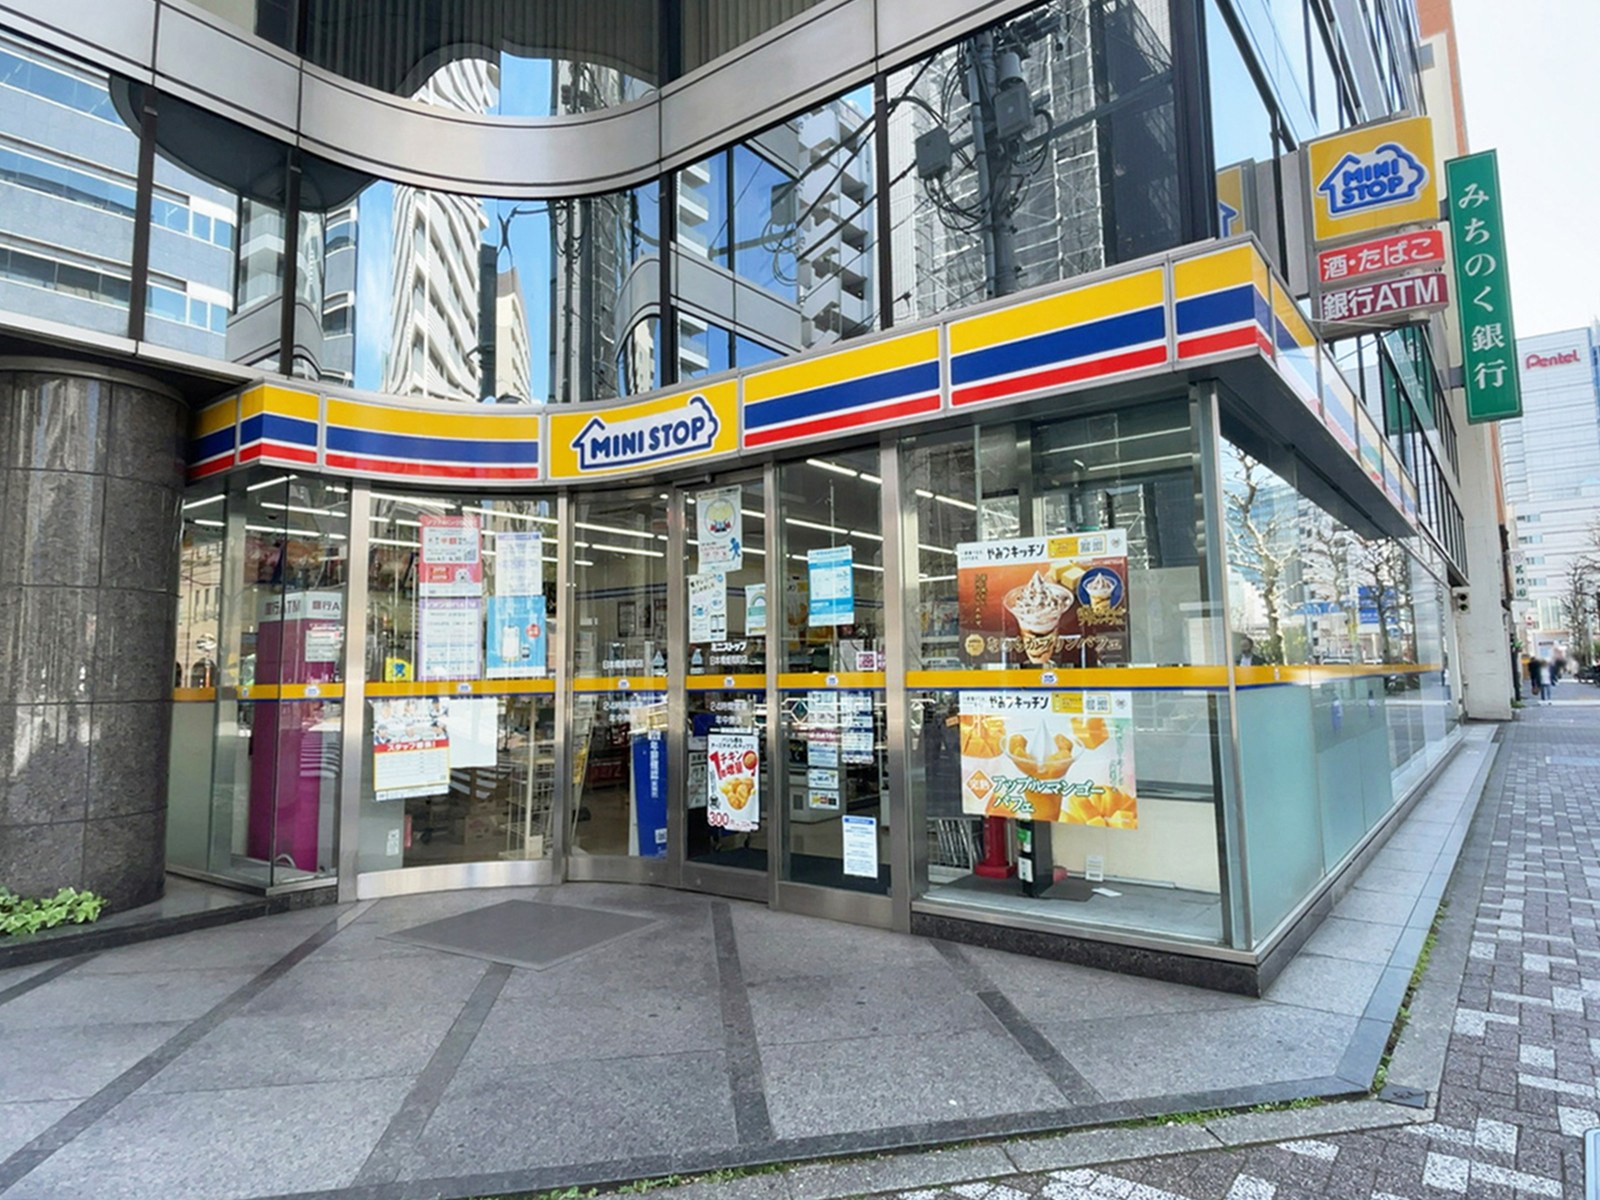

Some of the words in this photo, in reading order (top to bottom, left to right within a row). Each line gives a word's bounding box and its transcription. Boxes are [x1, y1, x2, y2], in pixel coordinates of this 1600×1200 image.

[1341, 176, 1404, 204] STOP
[1342, 158, 1399, 187] MINI
[1323, 238, 1435, 280] 酒・たばこ
[1323, 276, 1439, 321] 銀行ATM
[1458, 182, 1508, 391] みちのく銀行
[1525, 349, 1581, 370] Pentel
[590, 430, 645, 460] MINI
[649, 415, 705, 451] STOP
[991, 775, 1106, 797] アップルマンゴー
